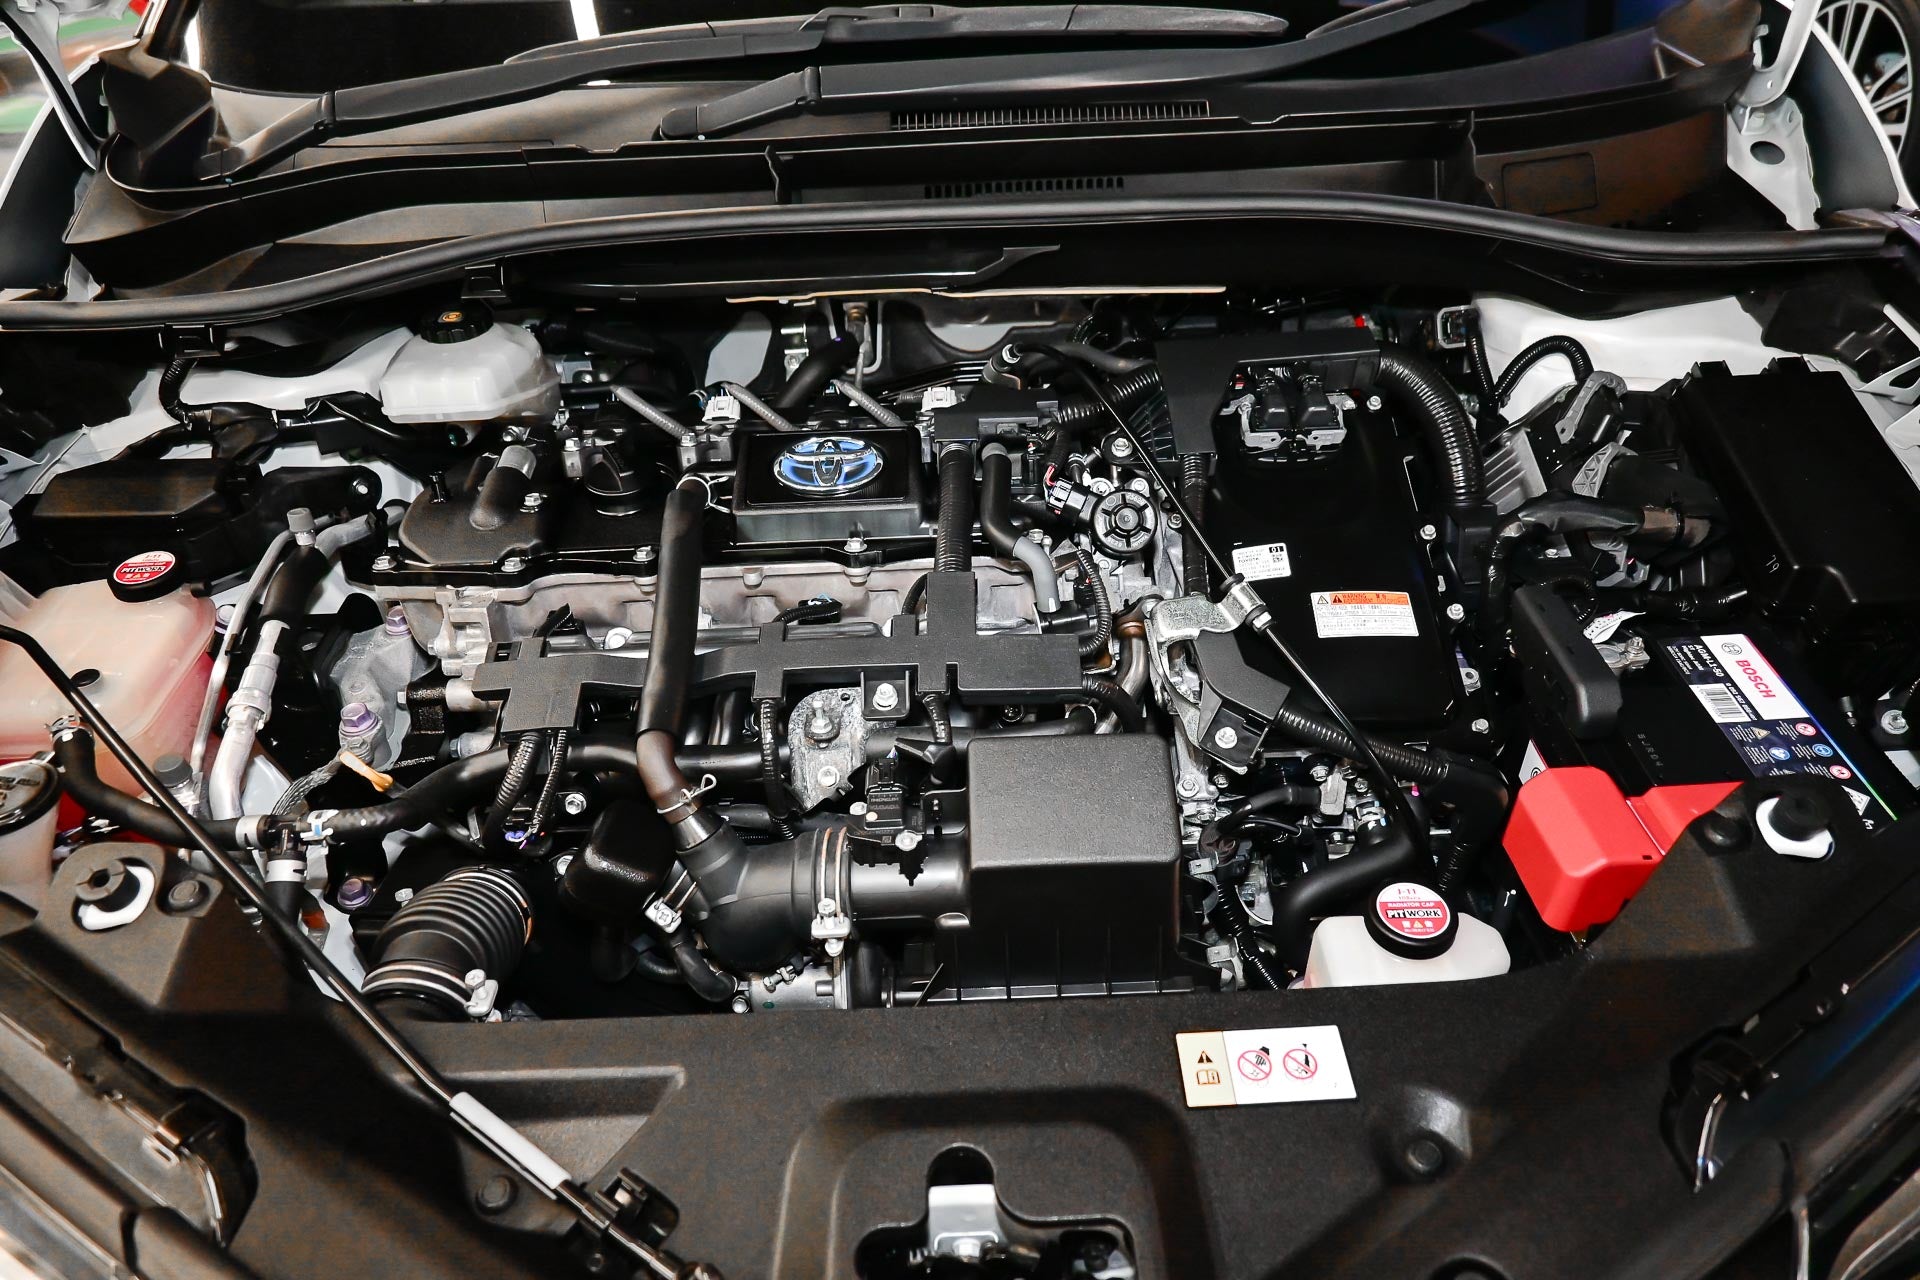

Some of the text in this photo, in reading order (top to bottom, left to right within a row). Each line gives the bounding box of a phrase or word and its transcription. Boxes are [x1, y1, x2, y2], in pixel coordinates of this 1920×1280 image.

[1693, 644, 1725, 677] AGM-L1-50
[1734, 659, 1776, 698] BOSCH
[1386, 909, 1442, 918] PITWORK
